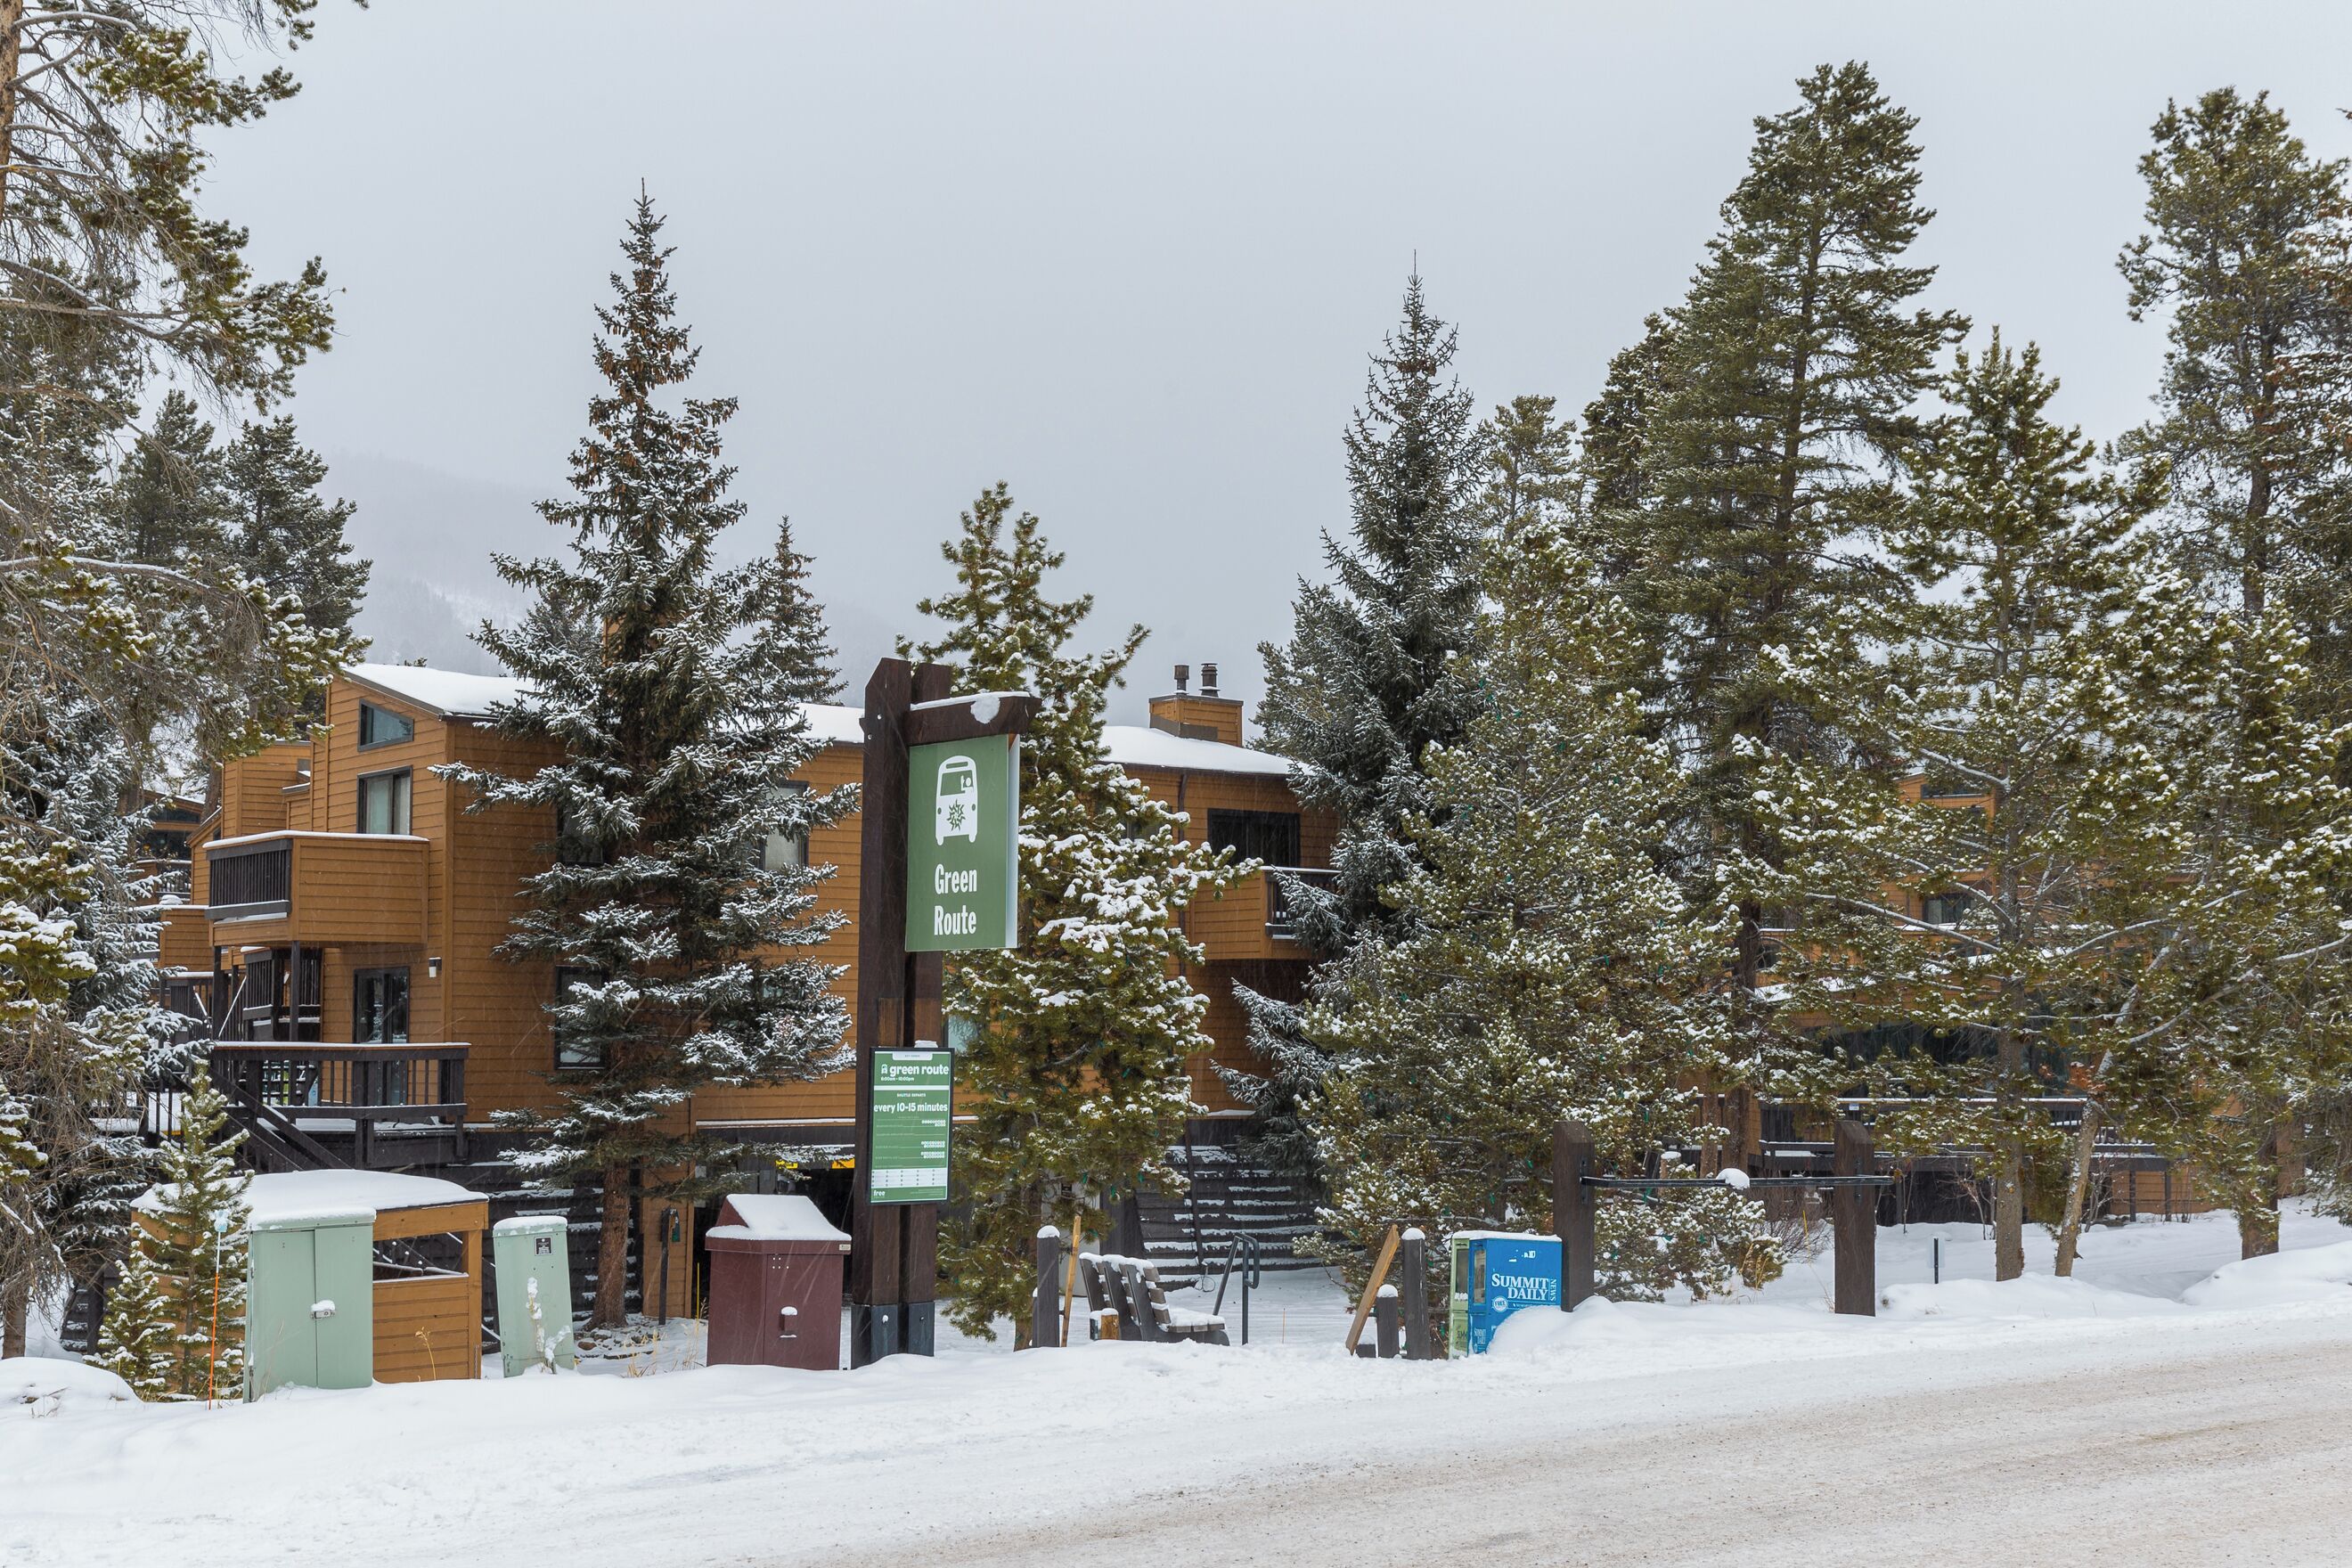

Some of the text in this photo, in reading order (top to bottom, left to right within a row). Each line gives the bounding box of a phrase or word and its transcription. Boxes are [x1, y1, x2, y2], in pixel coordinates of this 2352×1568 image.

[935, 863, 977, 894] Green
[934, 904, 977, 935] Route
[889, 1064, 950, 1077] green route
[873, 1102, 948, 1114] every 10-15 minutes
[1491, 1273, 1549, 1290] SUMMIT
[1507, 1286, 1548, 1301] DAILY
